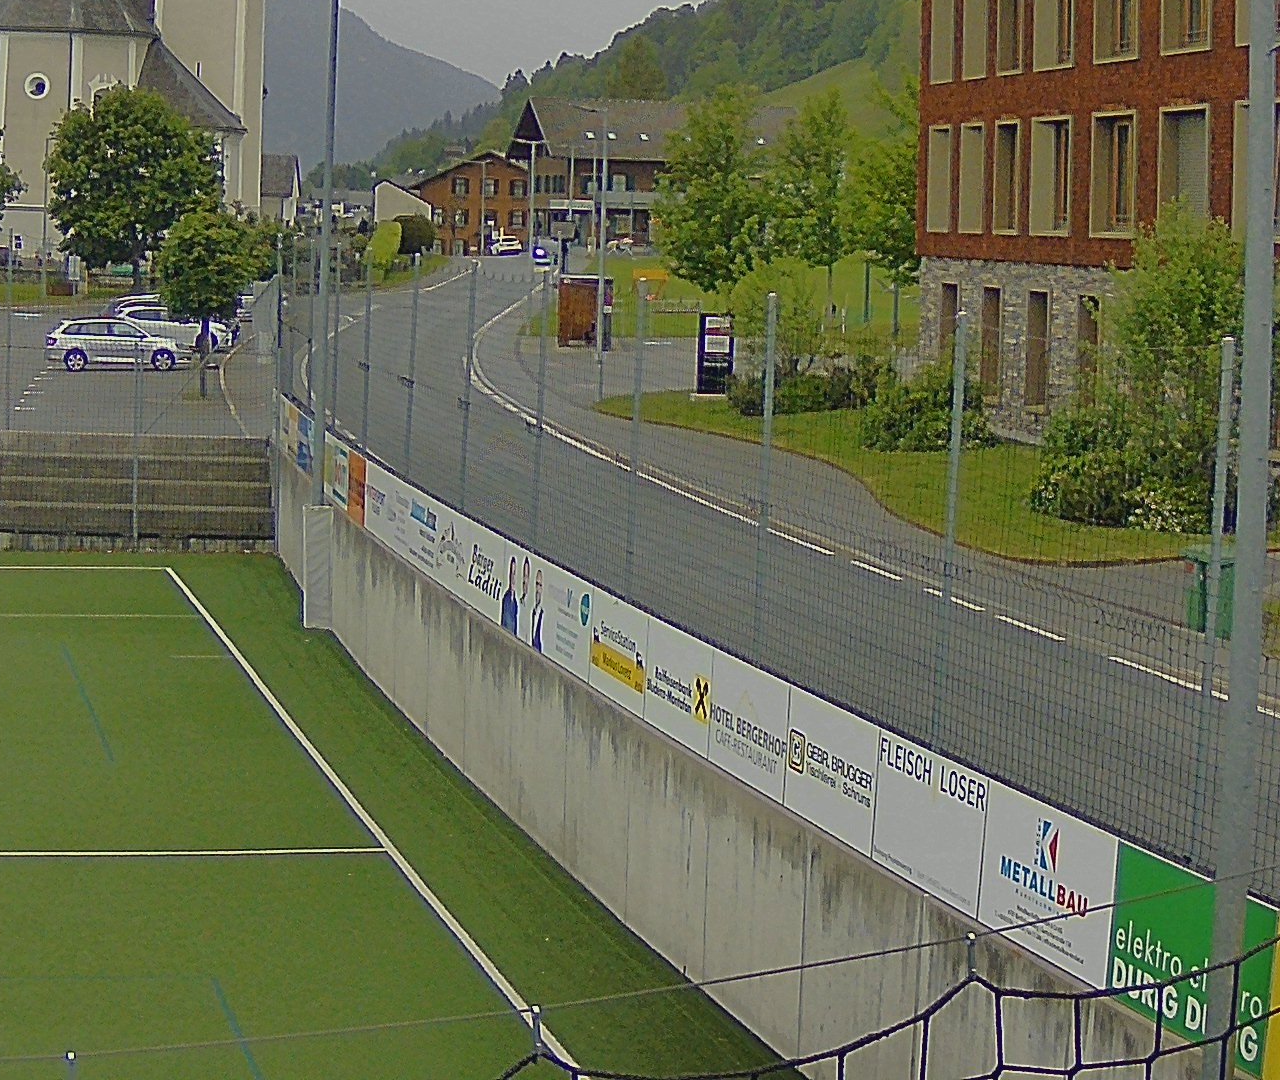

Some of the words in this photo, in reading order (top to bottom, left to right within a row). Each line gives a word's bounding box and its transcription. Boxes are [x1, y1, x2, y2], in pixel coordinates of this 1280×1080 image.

[467, 564, 502, 601] Lädili
[709, 703, 734, 731] HOTEL
[842, 782, 871, 808] Schruns
[880, 737, 933, 786] FLEISCH
[939, 766, 986, 812] LOSER
[1000, 855, 1088, 917] METALLBAU
[1115, 920, 1182, 977] elektro
